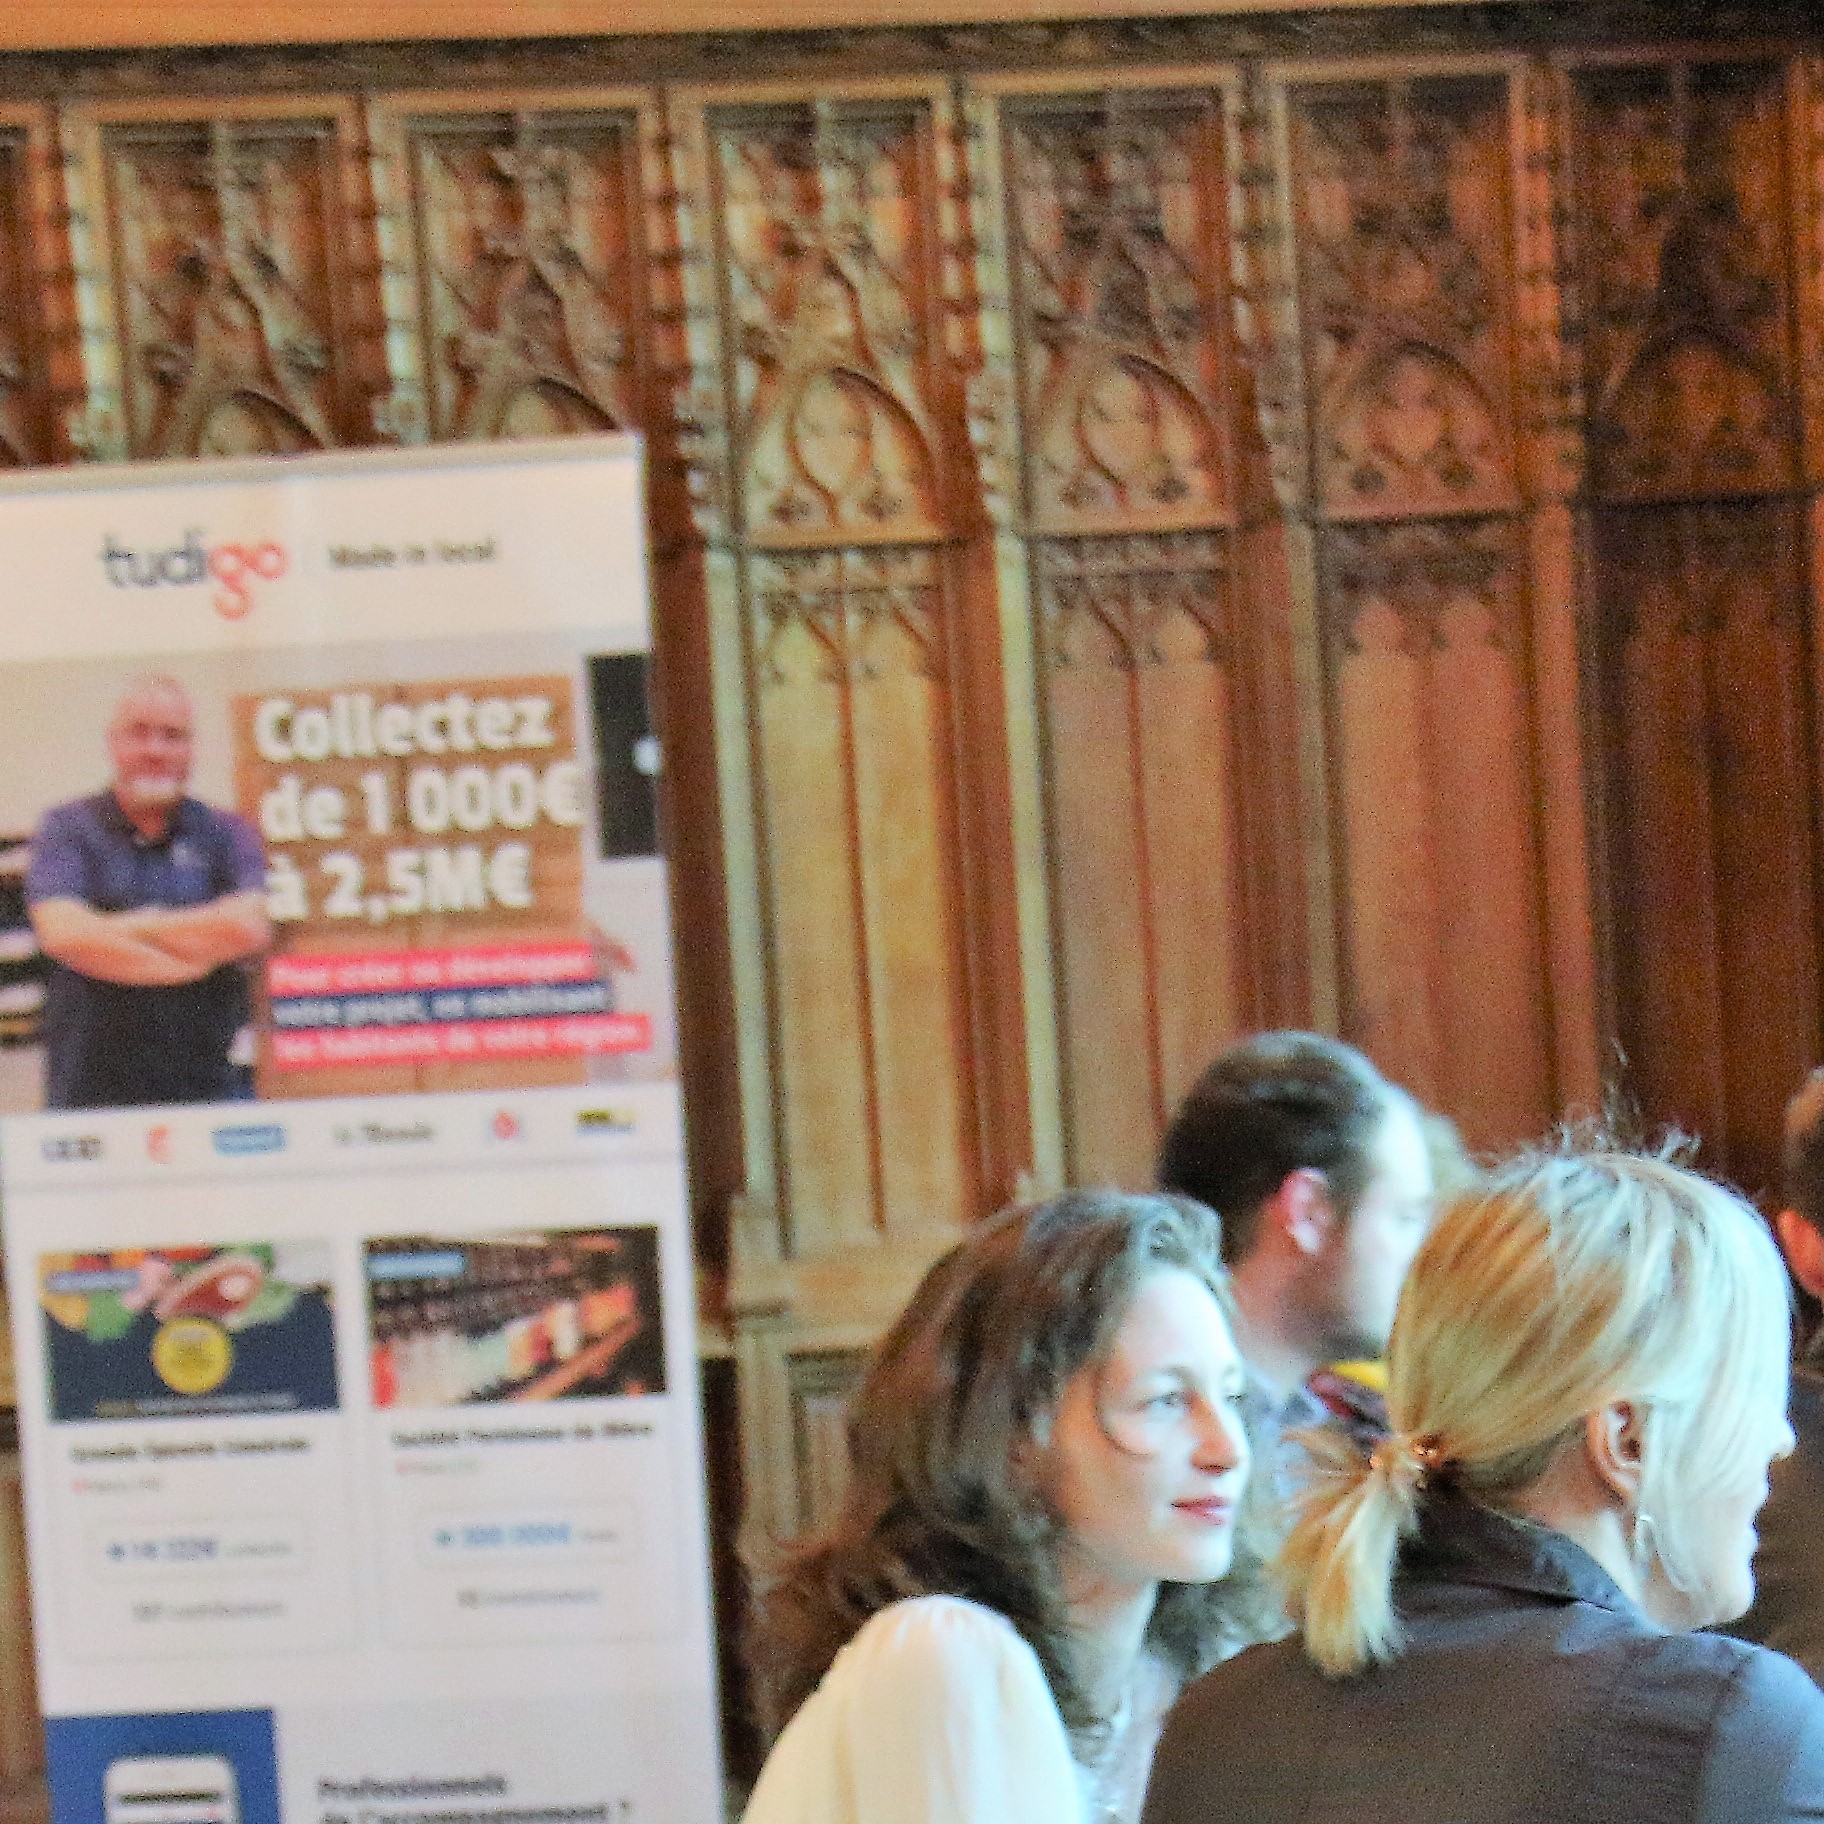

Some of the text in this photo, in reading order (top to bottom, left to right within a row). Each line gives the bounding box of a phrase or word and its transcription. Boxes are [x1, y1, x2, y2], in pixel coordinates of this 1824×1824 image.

[102, 525, 289, 620] tudigo
[254, 693, 556, 763] Collectez
[260, 759, 589, 842] de 1 000€
[266, 842, 534, 925] à 2,5M€
